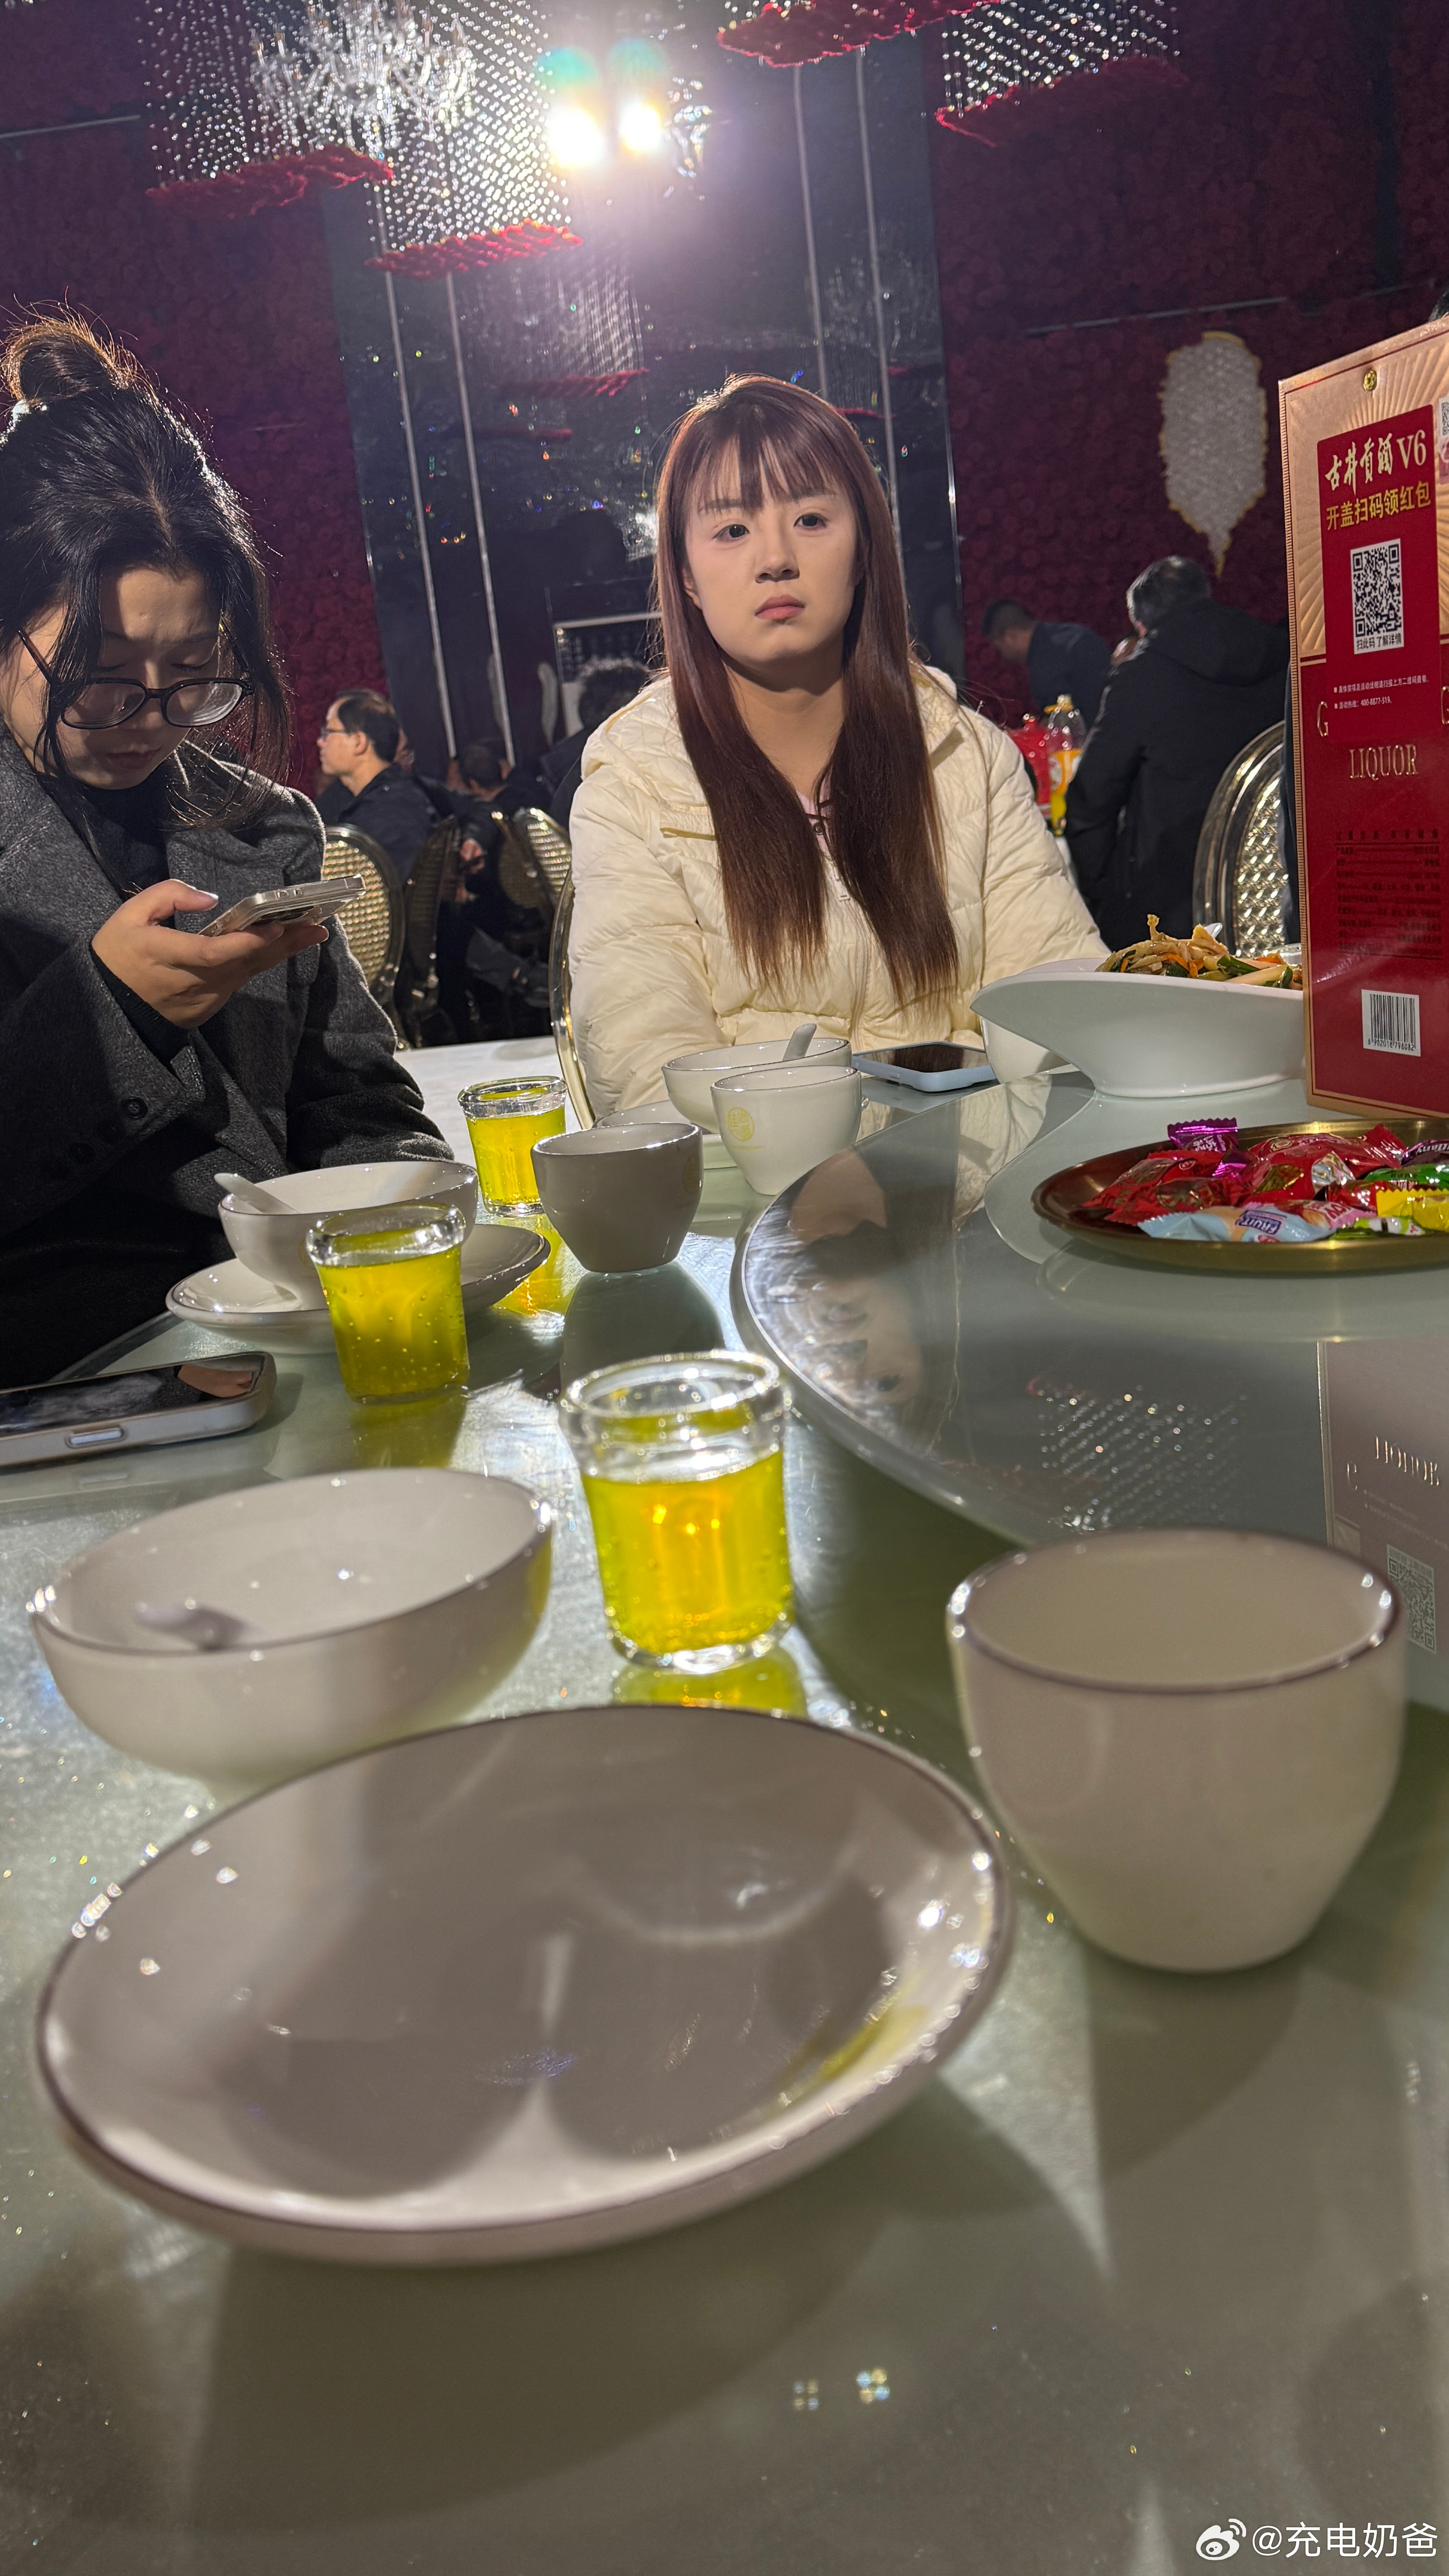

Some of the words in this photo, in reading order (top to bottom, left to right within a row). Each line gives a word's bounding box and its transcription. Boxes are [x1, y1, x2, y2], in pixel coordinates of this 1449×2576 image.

[1396, 429, 1426, 469] V6
[1326, 481, 1431, 531] 开盖扫码领红包
[1349, 744, 1419, 781] LIQUOR
[1242, 1218, 1279, 1234] FRUIT
